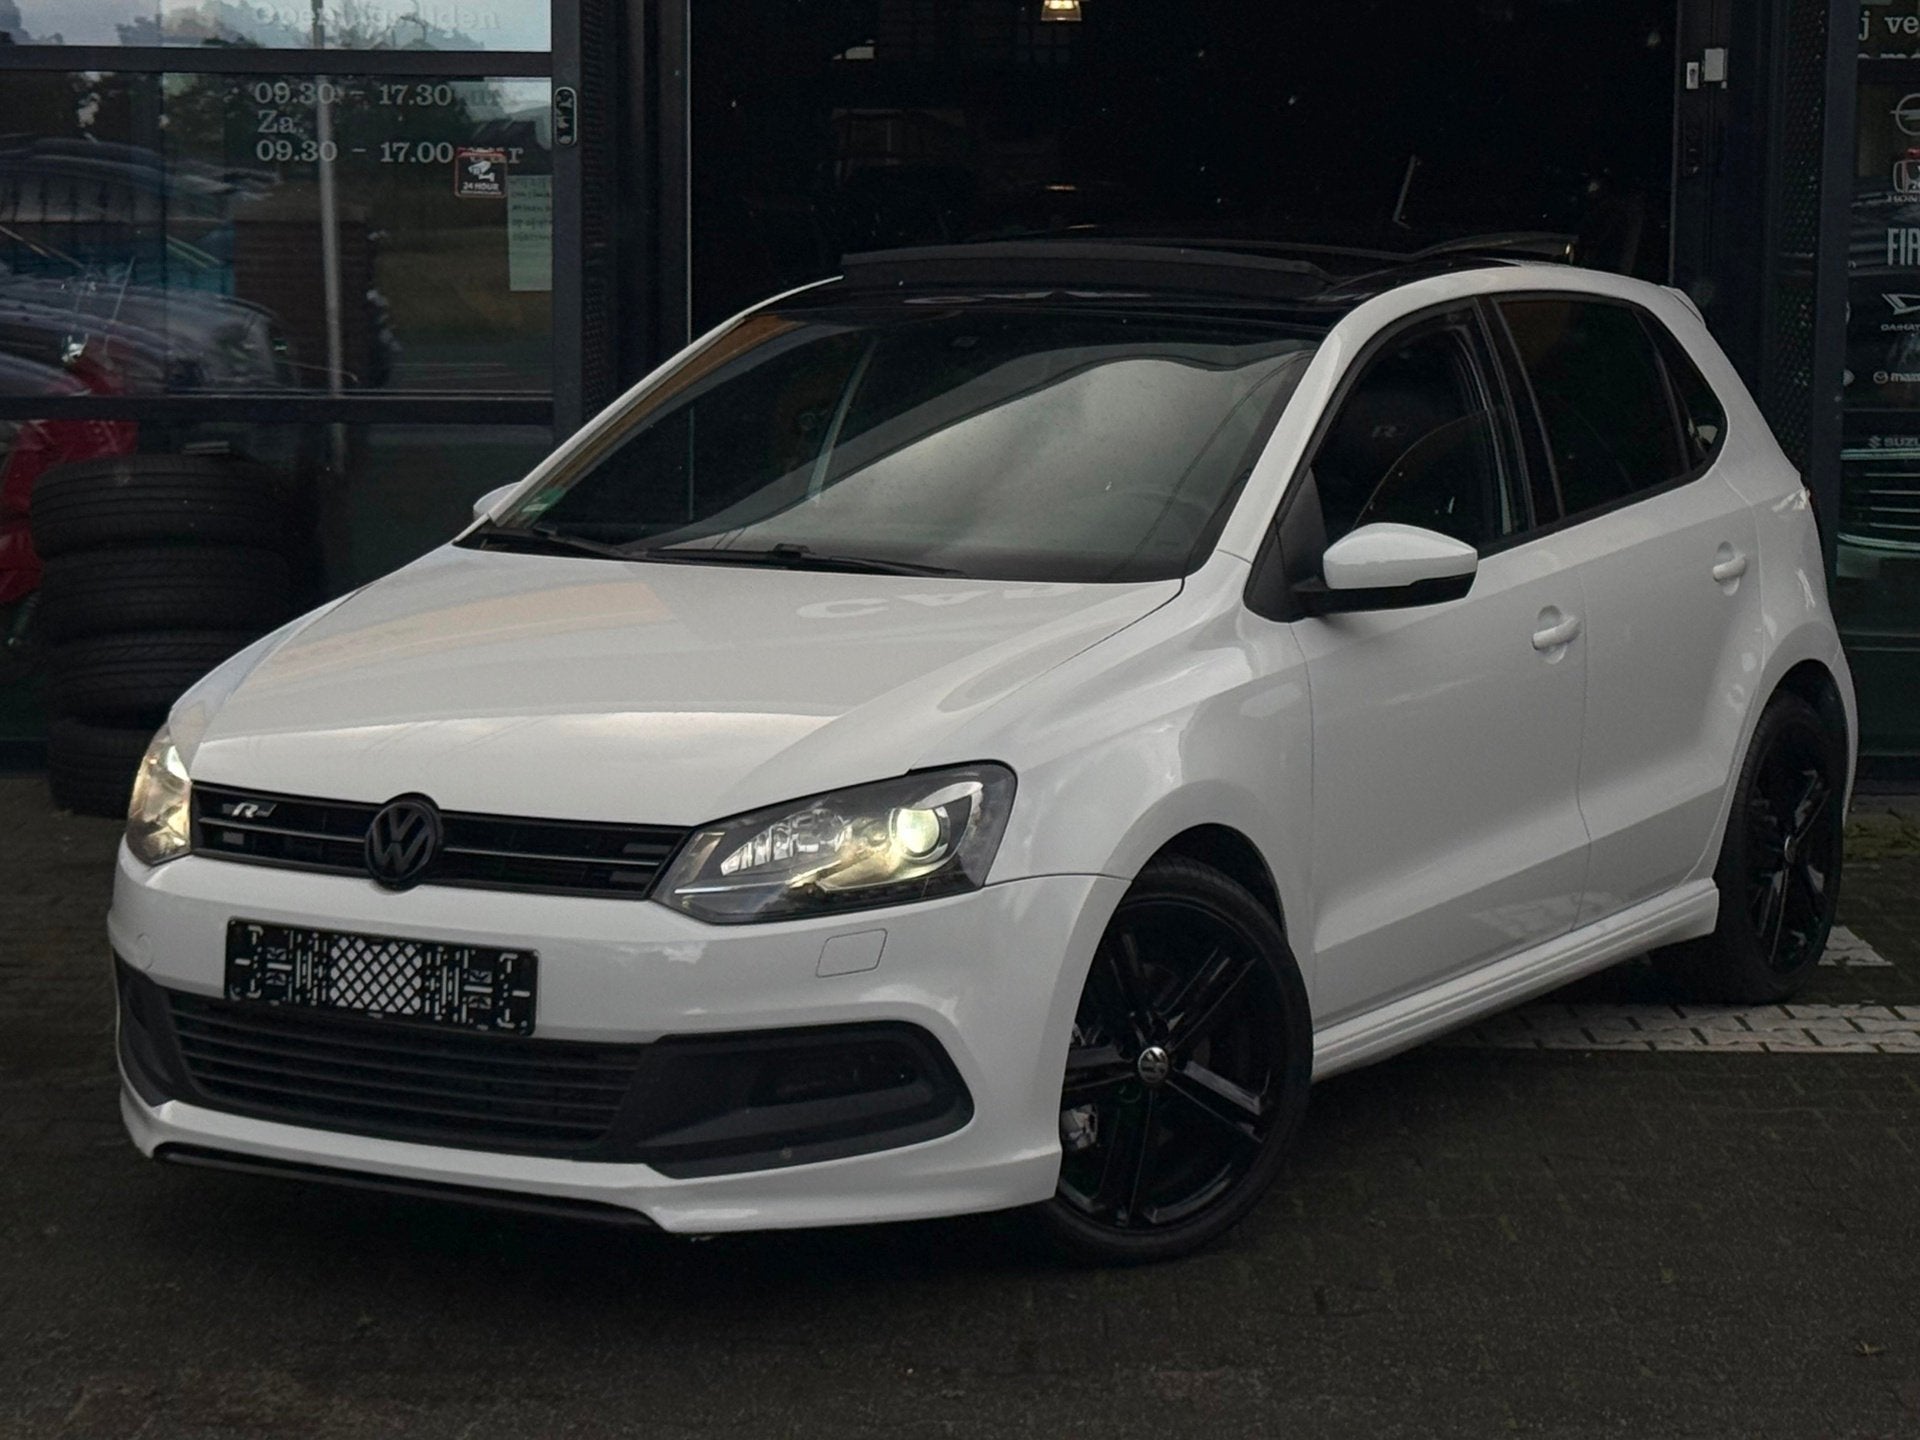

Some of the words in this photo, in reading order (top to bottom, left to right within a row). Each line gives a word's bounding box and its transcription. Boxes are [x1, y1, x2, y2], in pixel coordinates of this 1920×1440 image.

[254, 82, 336, 105] 09.30
[378, 84, 452, 106] 17.30
[257, 109, 304, 133] Za.
[255, 140, 338, 162] 09.30
[380, 142, 455, 164] 17.00
[474, 183, 500, 191] HOUR
